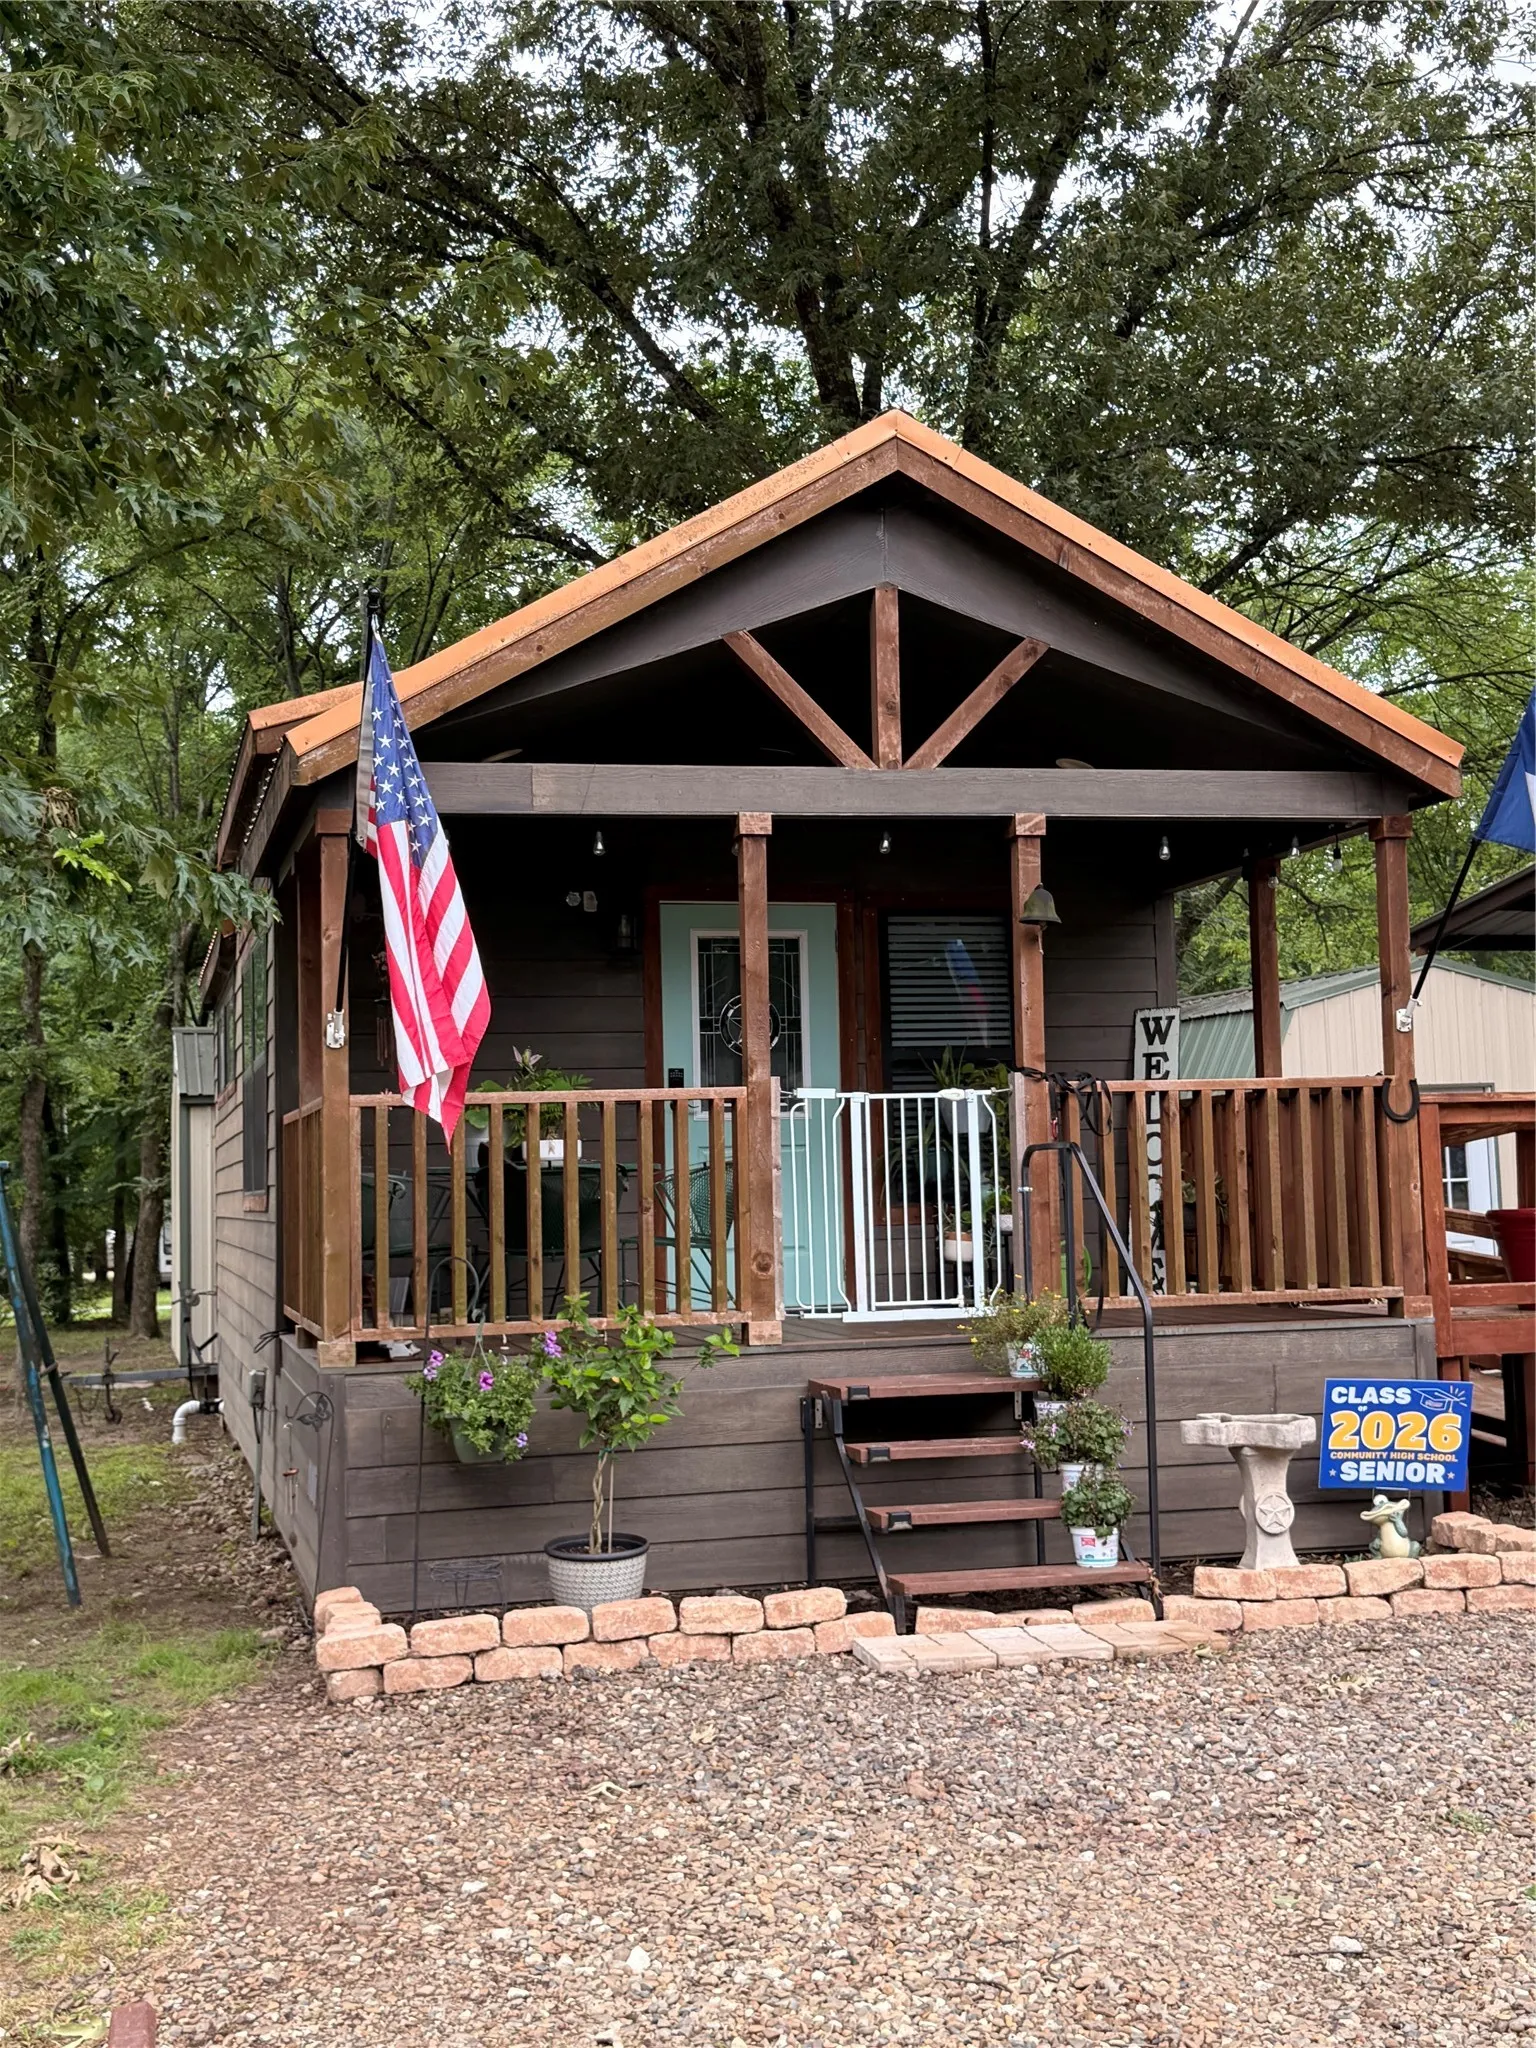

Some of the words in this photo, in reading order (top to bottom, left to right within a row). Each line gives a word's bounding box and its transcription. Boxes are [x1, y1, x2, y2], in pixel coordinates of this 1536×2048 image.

[1331, 1386, 1412, 1405] CLASS
[1328, 1410, 1463, 1453] 2026
[1330, 1451, 1388, 1460] COMMUNITY
[1390, 1452, 1415, 1461] HIGH
[1417, 1453, 1459, 1463] SCHOOL
[1339, 1461, 1446, 1484] SENIOR
